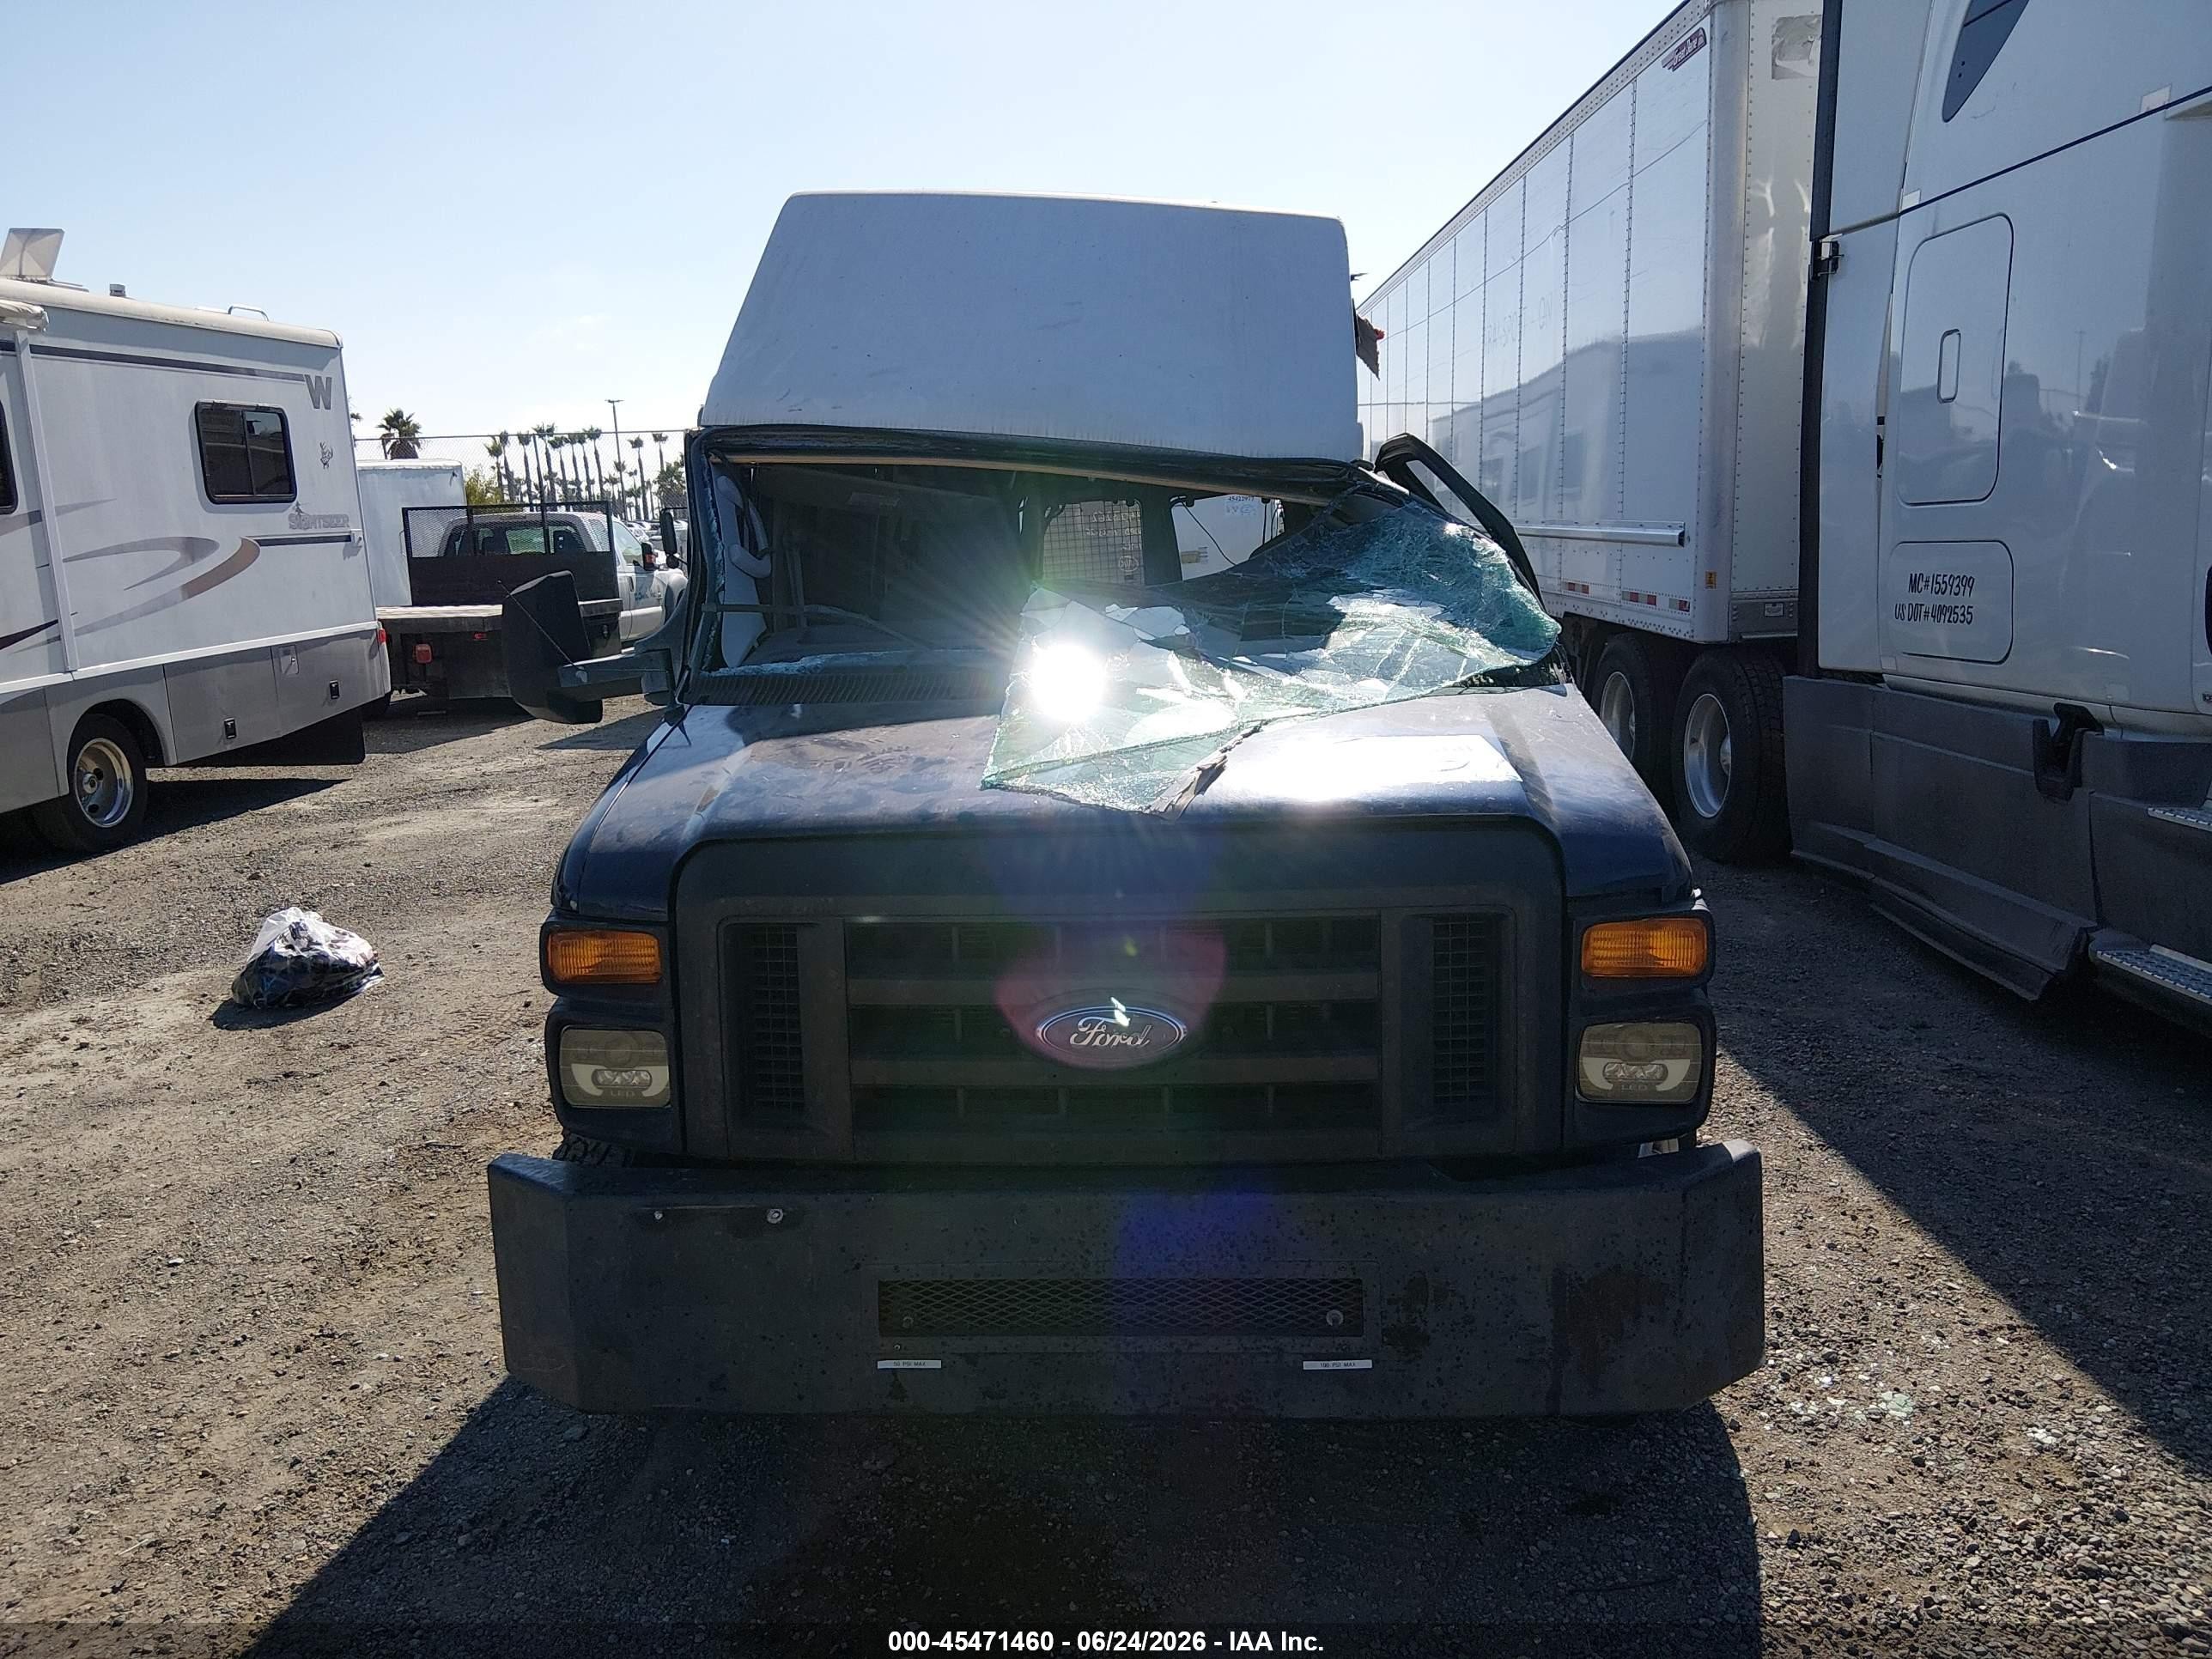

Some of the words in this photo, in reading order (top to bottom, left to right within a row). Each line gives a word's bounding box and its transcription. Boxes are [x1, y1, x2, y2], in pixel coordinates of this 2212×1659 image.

[304, 374, 332, 410] W
[1908, 573, 1975, 598] MC#1559399
[1894, 603, 1906, 621] US
[1907, 603, 1973, 625] DOT#4092535
[1070, 1016, 1152, 1048] Ford
